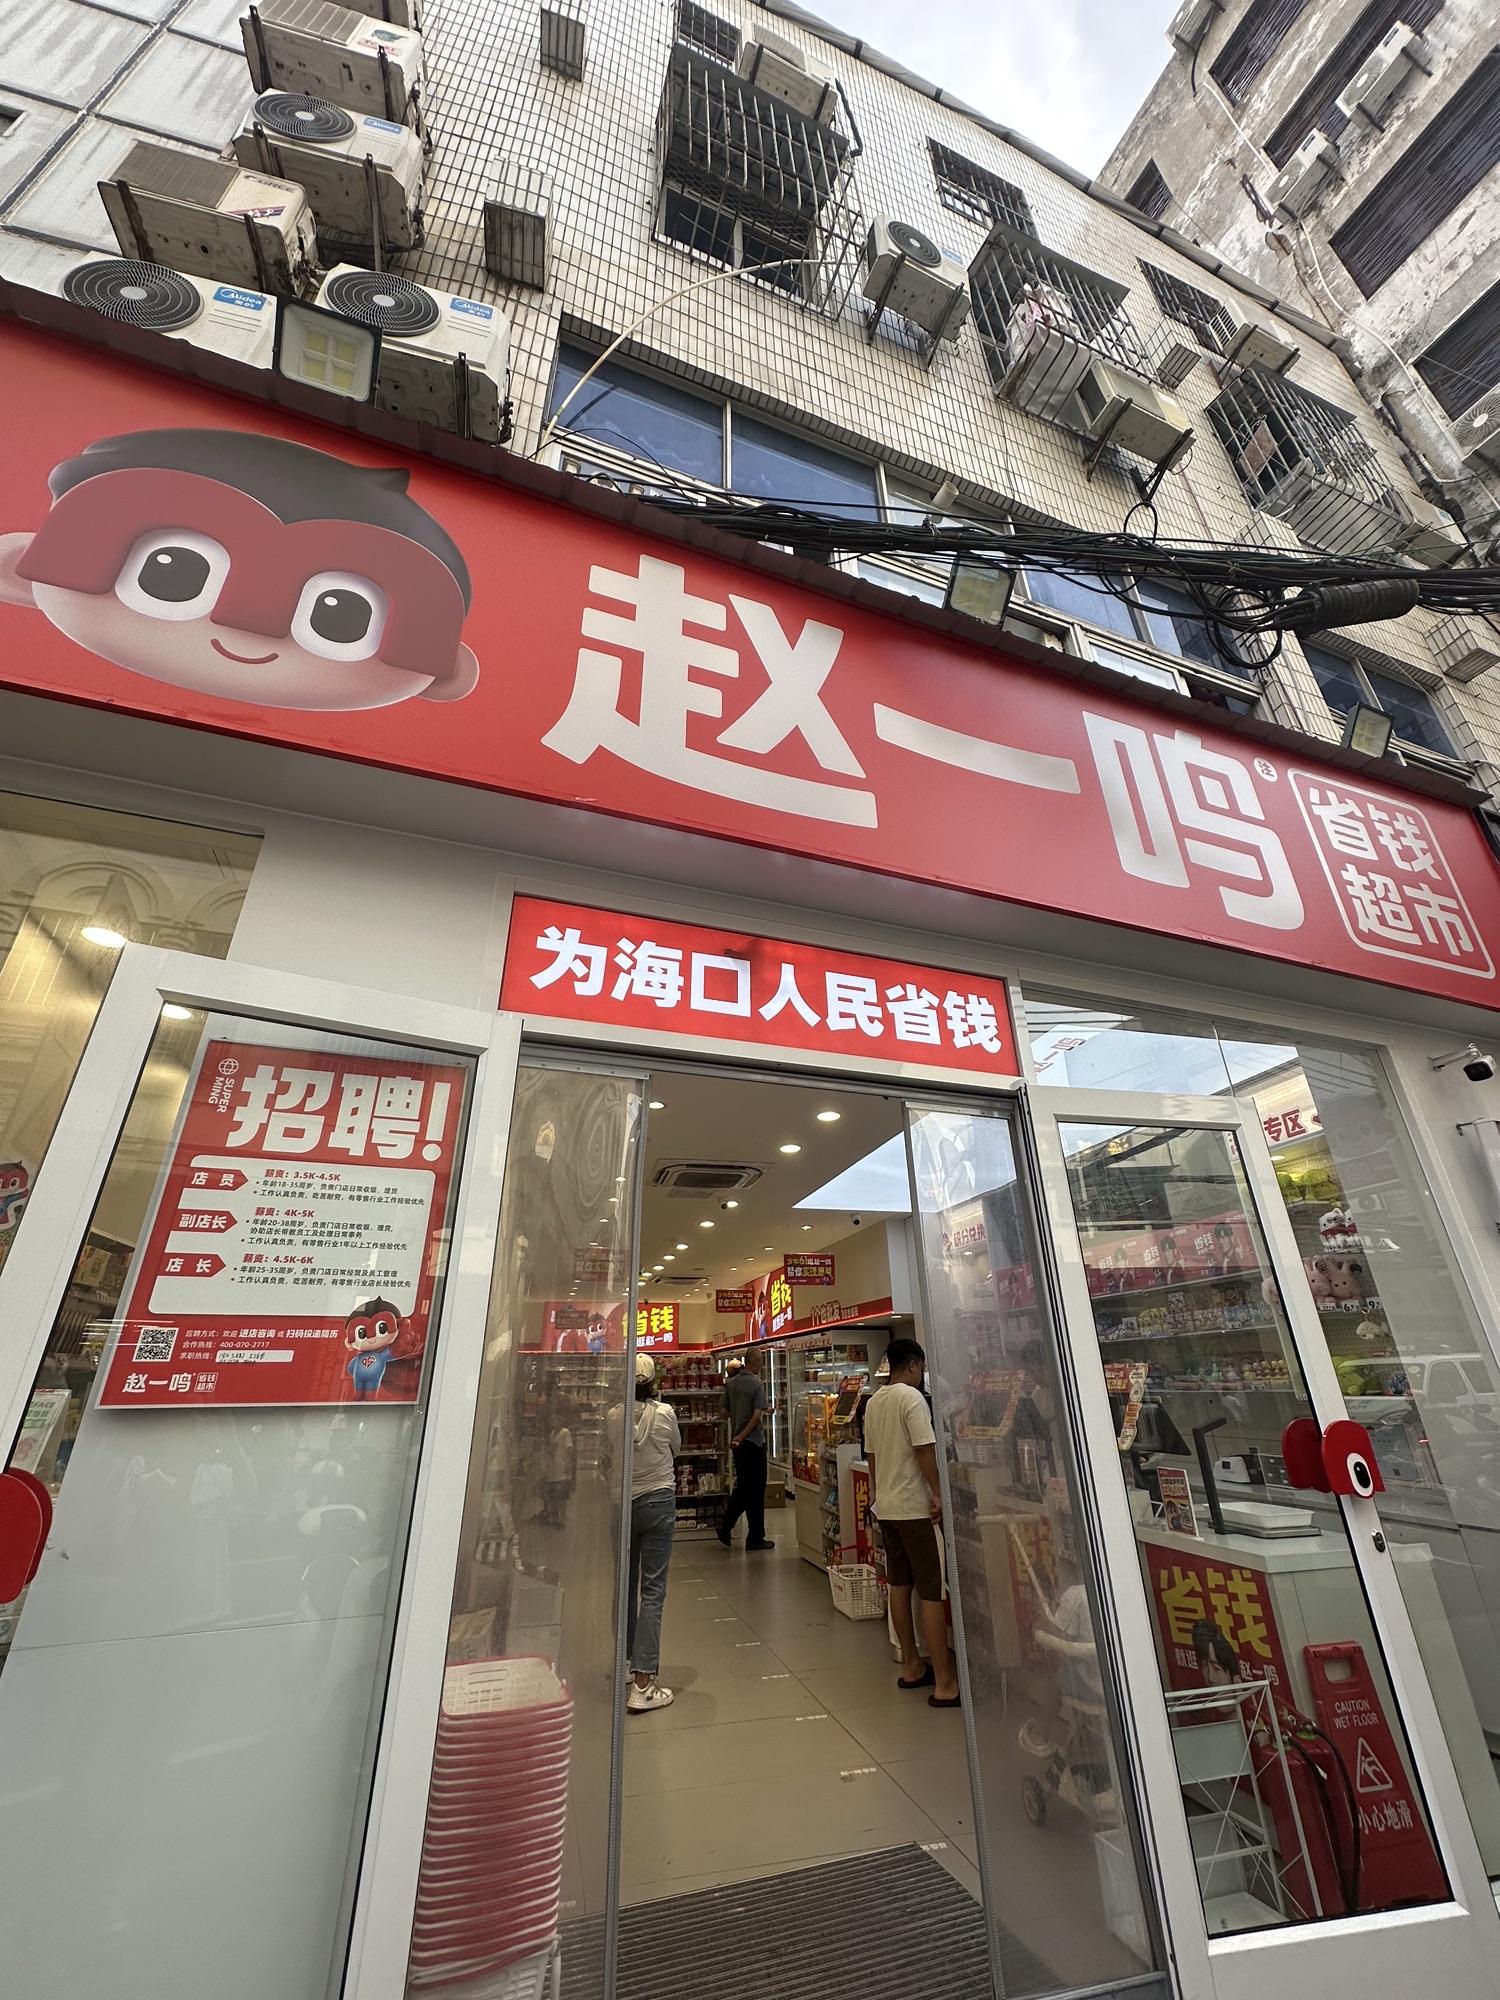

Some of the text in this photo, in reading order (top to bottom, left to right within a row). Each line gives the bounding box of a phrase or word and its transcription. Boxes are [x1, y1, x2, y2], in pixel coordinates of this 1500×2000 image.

[220, 288, 262, 305] Midea
[455, 299, 491, 315] Midea
[540, 553, 1305, 930] 赵一鸣
[1257, 760, 1275, 778] 注
[1308, 784, 1437, 878] 省钱
[1342, 864, 1478, 960] 超市
[528, 924, 1003, 1055] 为海口人民省钱
[207, 1076, 224, 1105] MING
[216, 1077, 235, 1114] SUPER
[1262, 1108, 1307, 1142] 专区
[190, 1171, 235, 1187] 店员
[178, 1213, 228, 1230] 副店长
[165, 1258, 212, 1273] 店长
[122, 1372, 193, 1393] 赵一鸣
[197, 1382, 215, 1391] 超市
[198, 1374, 216, 1382] 省钱
[1159, 1565, 1273, 1659] 省钱
[1238, 1658, 1280, 1686] 赵一鸣
[1334, 1698, 1370, 1714] CAUTION
[1333, 1712, 1379, 1729] WET FLOOR
[1358, 1799, 1414, 1835] 小心地滑
